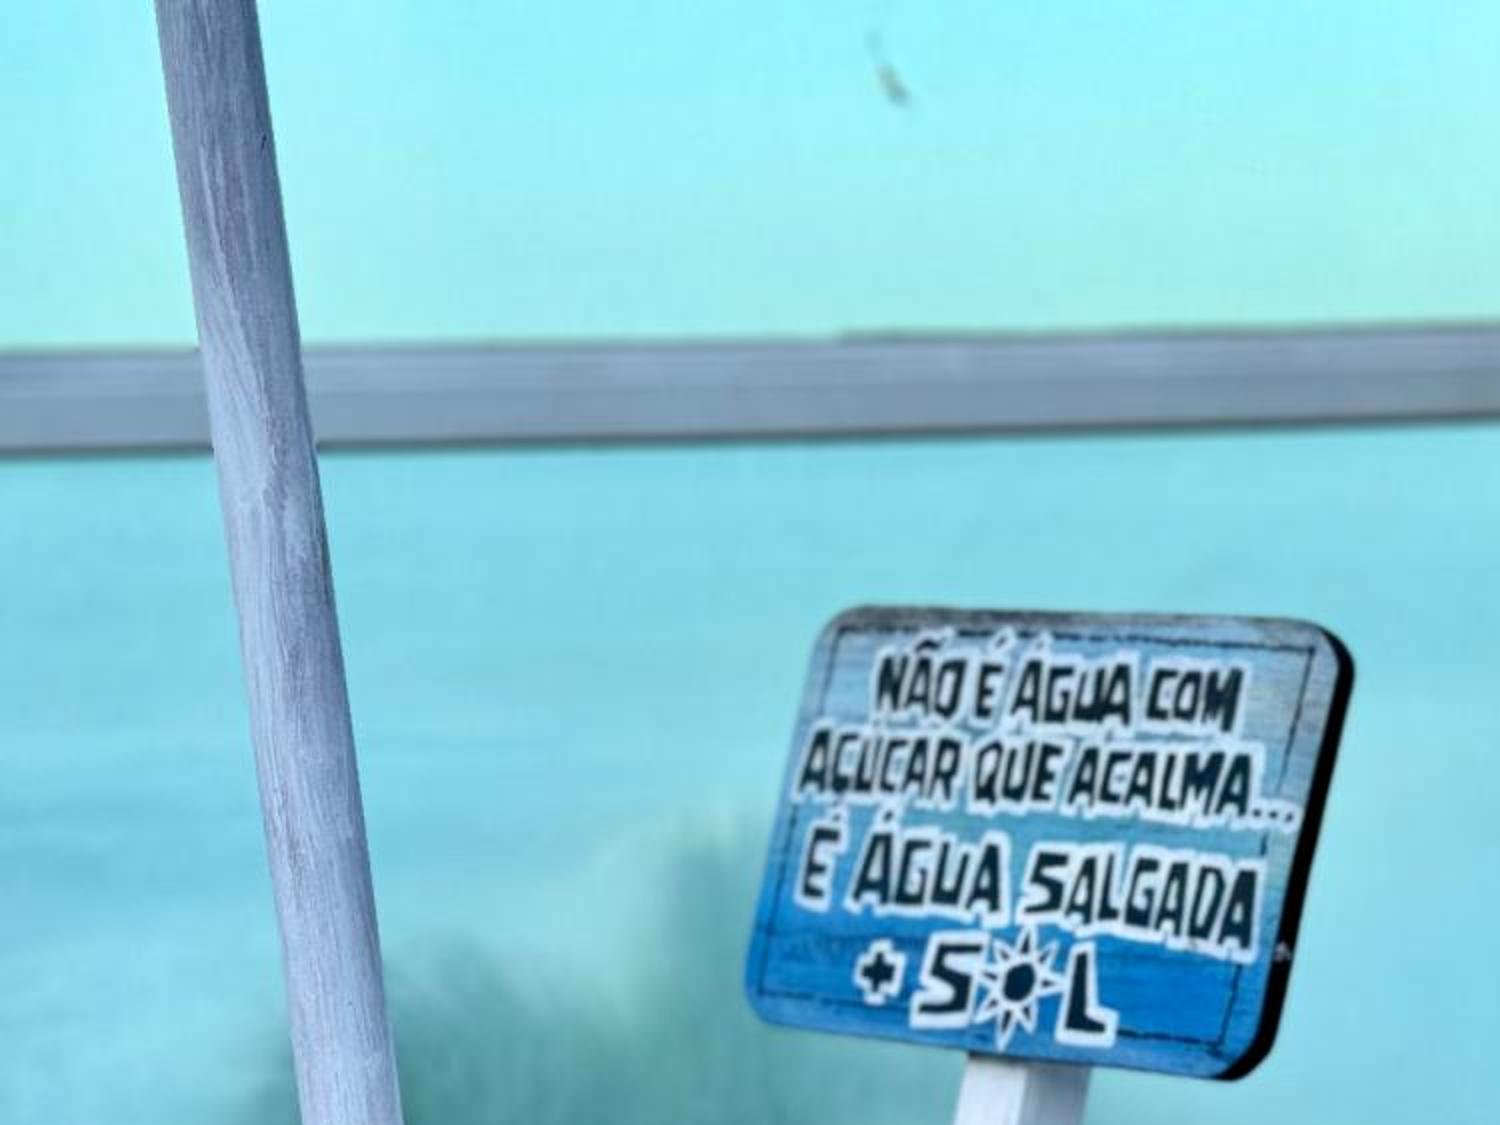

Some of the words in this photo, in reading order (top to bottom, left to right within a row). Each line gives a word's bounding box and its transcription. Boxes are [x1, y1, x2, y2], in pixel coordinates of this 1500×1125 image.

[875, 637, 968, 720] NÃO
[1146, 665, 1245, 734] COM
[974, 738, 1065, 805] QUE
[850, 810, 1003, 914] ÁGUA
[1022, 849, 1259, 951] SALGADA
